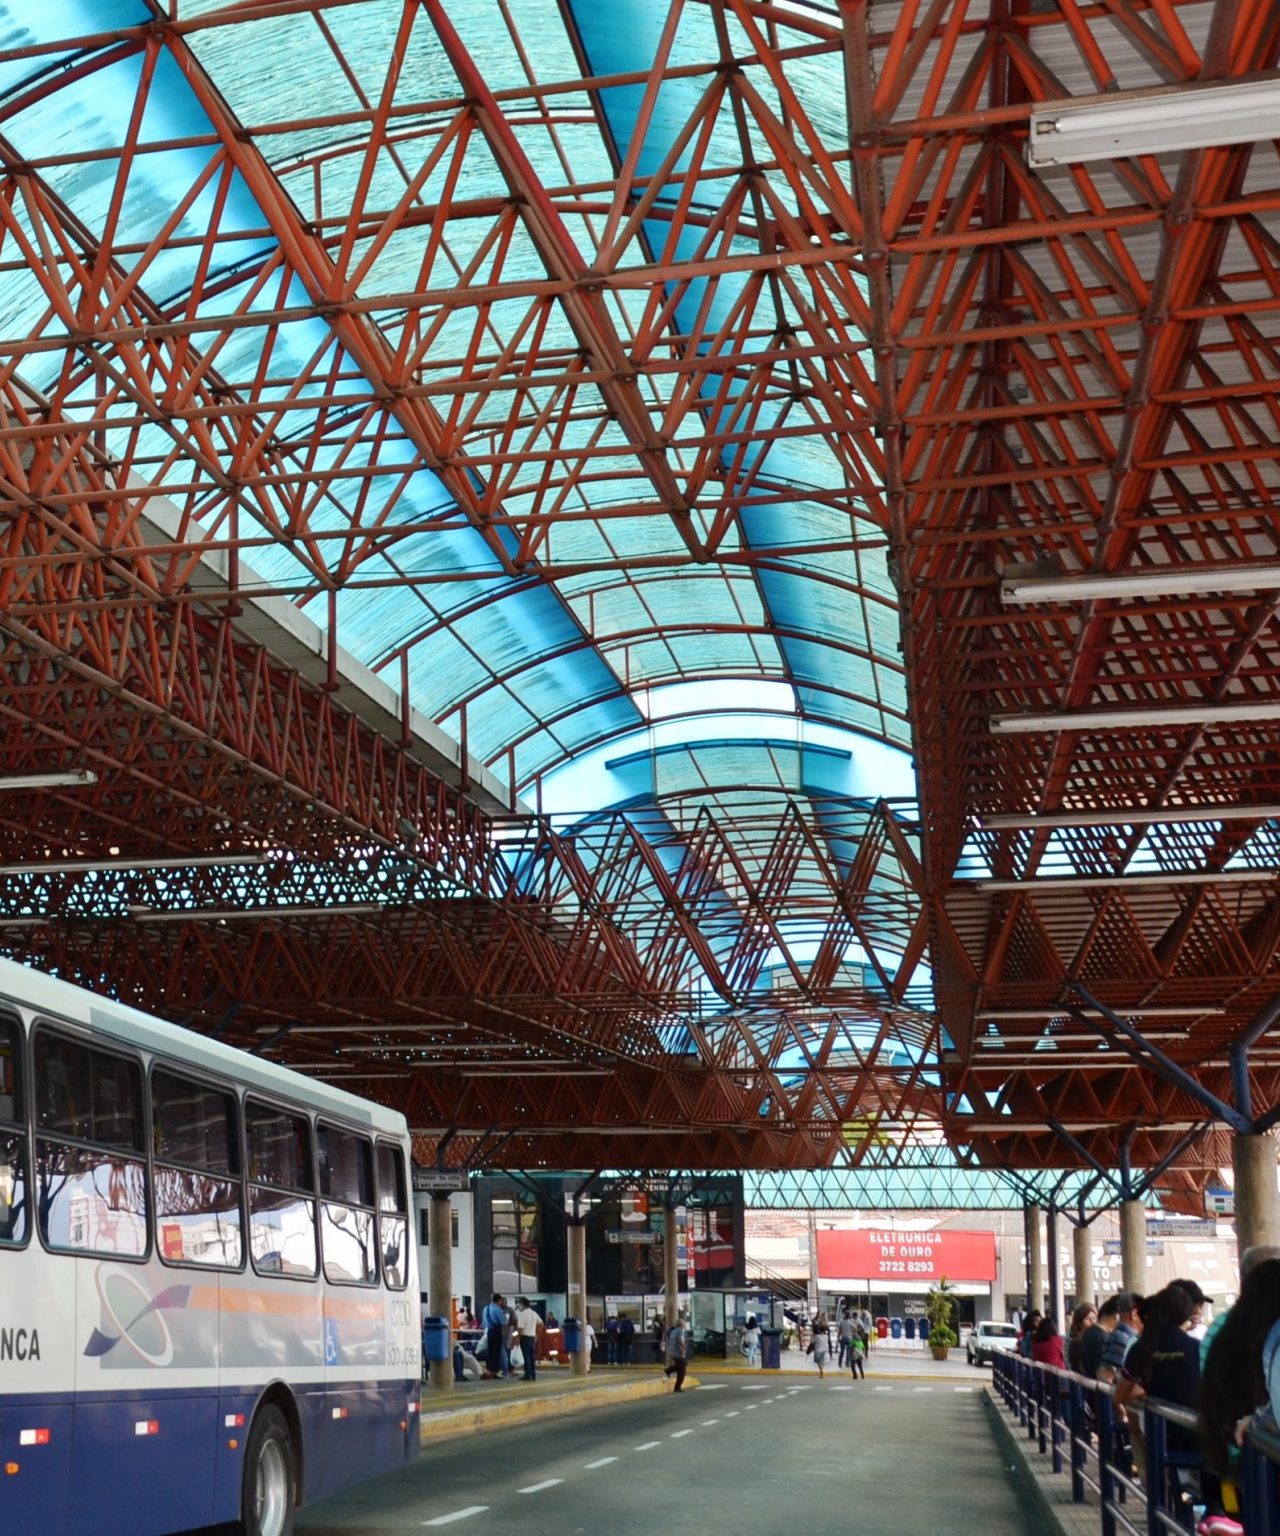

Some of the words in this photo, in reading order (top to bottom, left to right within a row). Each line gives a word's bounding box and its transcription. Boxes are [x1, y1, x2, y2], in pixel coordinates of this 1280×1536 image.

[881, 1246, 896, 1257] DE
[900, 1246, 932, 1257] OURO
[879, 1261, 905, 1271] 3722
[907, 1261, 934, 1272] 8293
